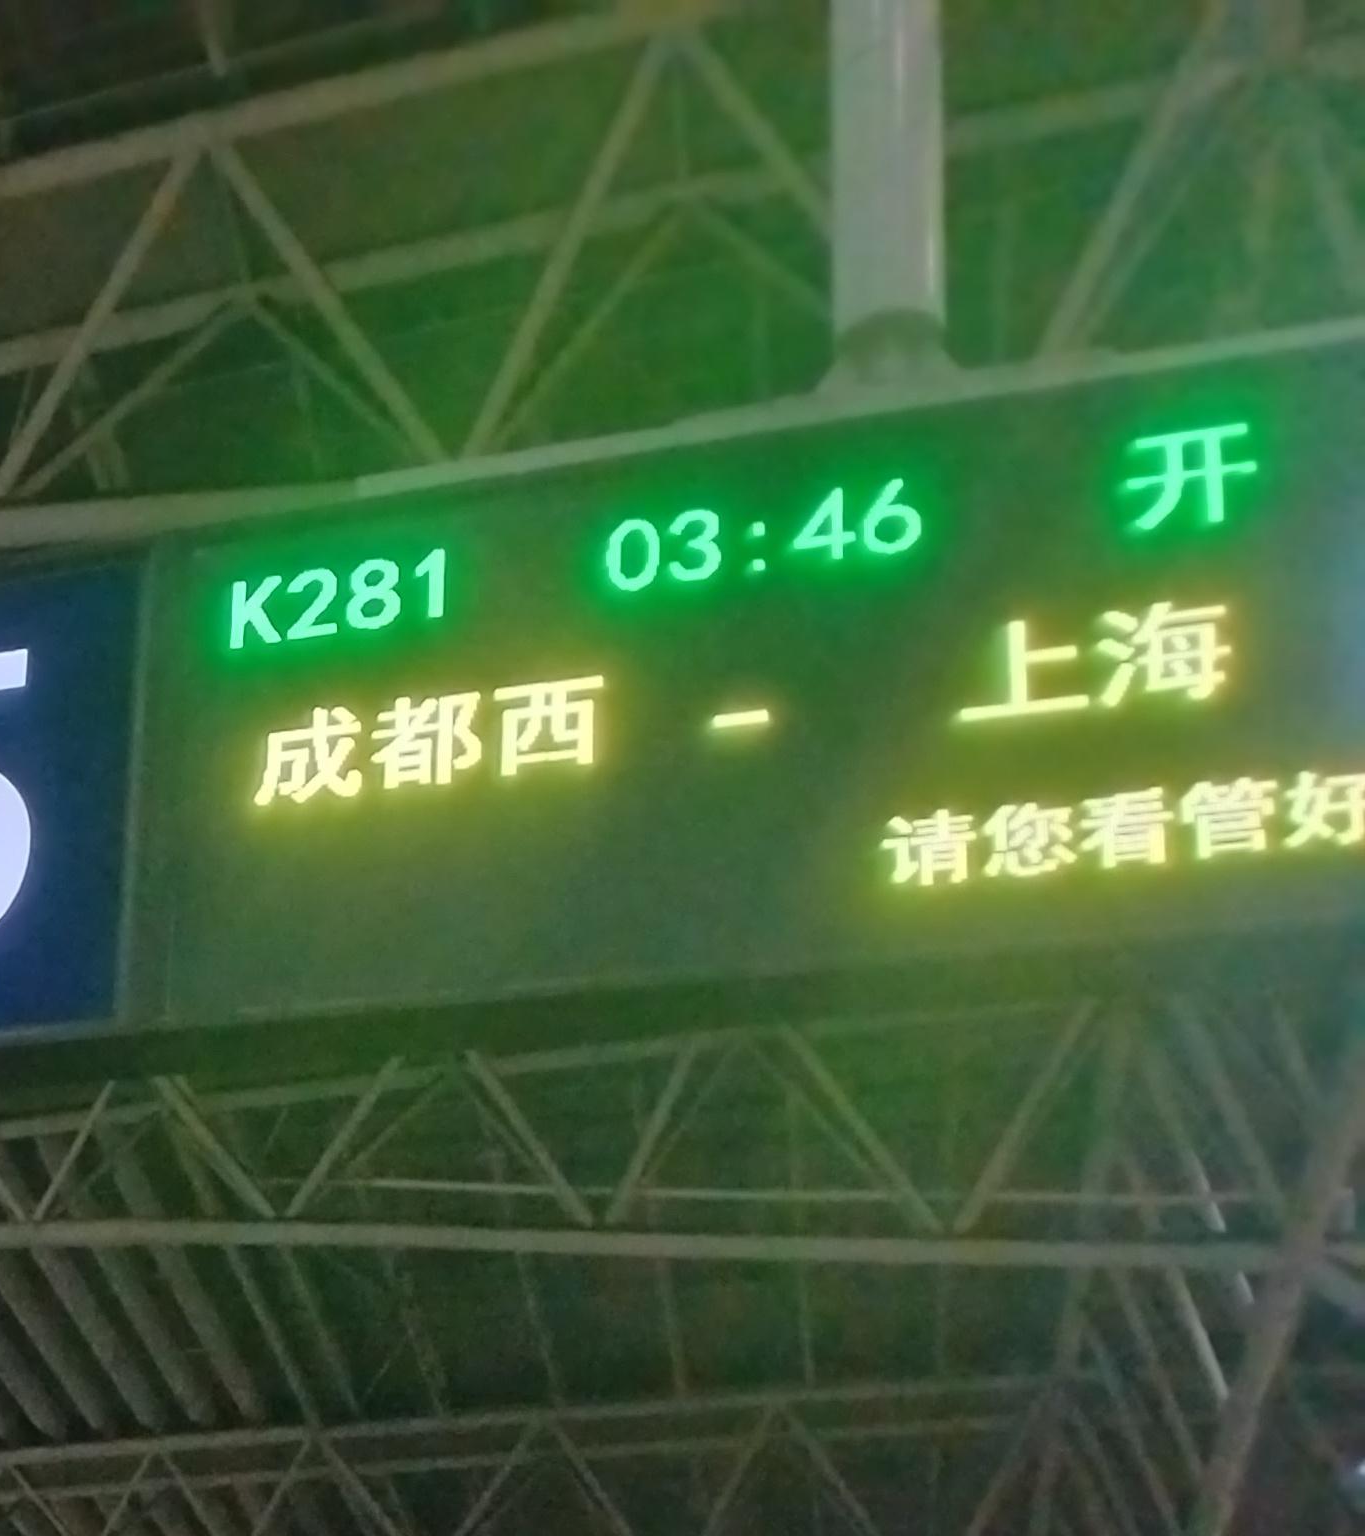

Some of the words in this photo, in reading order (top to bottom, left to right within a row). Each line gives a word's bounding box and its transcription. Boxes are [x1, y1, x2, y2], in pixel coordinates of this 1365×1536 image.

[228, 547, 447, 650] K281
[604, 477, 923, 592] 03:46
[1124, 422, 1259, 532] 开
[252, 674, 605, 807] 成都西
[957, 601, 1234, 729] 上海
[880, 769, 1365, 887] 请您看管好
